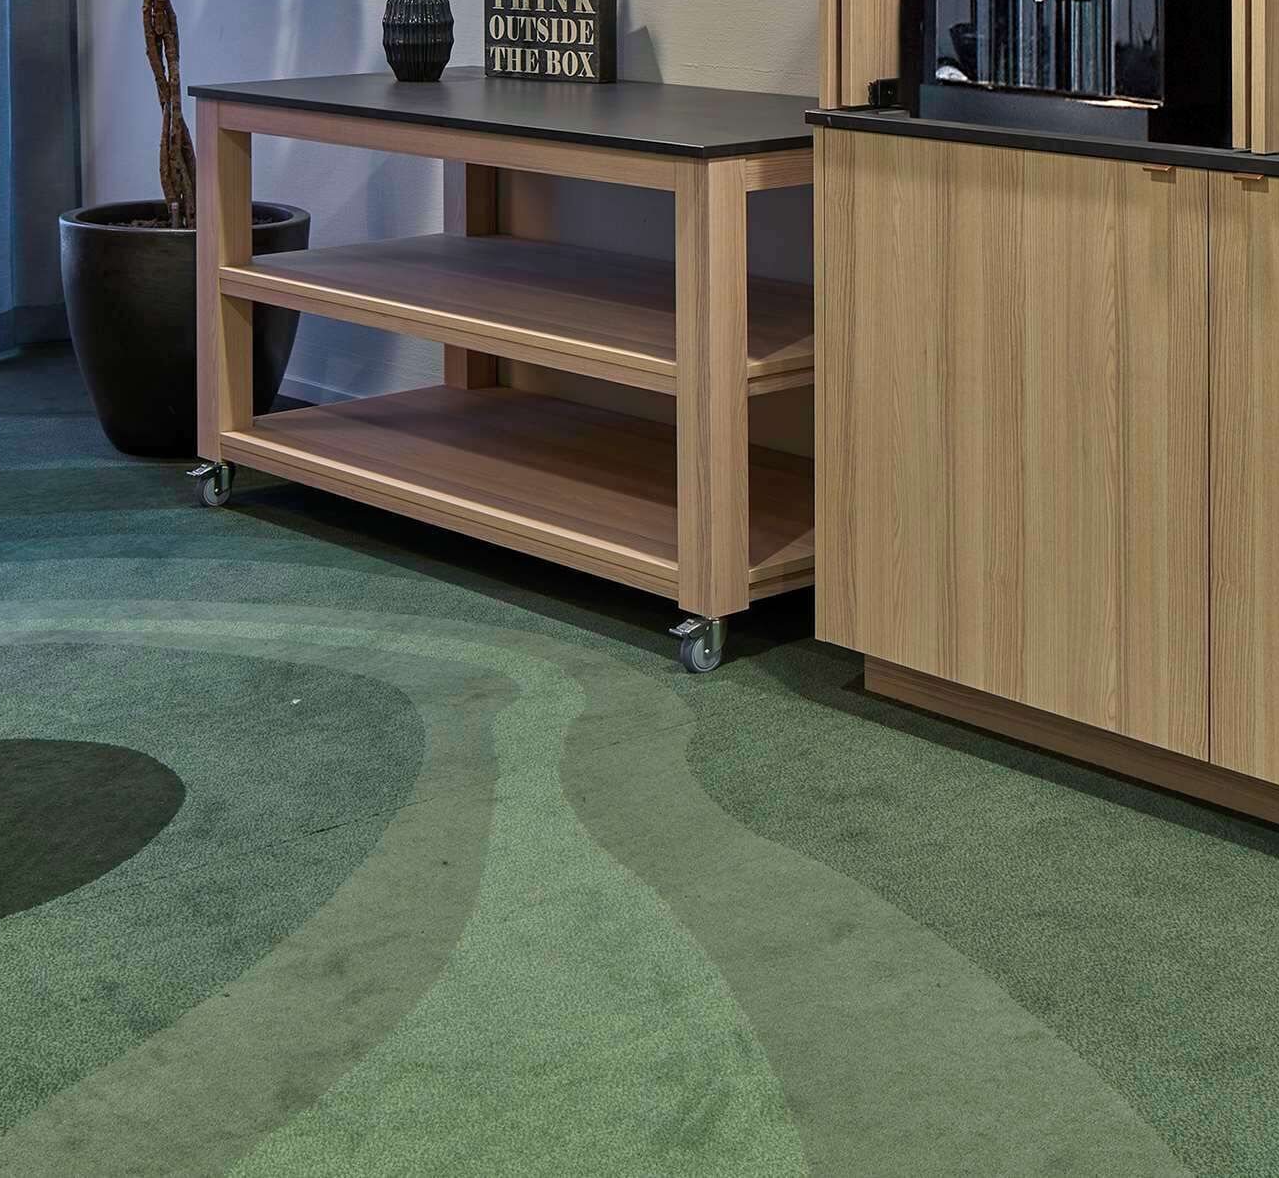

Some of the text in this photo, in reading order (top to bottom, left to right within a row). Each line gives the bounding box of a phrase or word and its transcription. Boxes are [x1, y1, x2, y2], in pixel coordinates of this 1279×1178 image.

[489, 14, 595, 46] OUTSIDE
[490, 46, 596, 78] THE BOX
